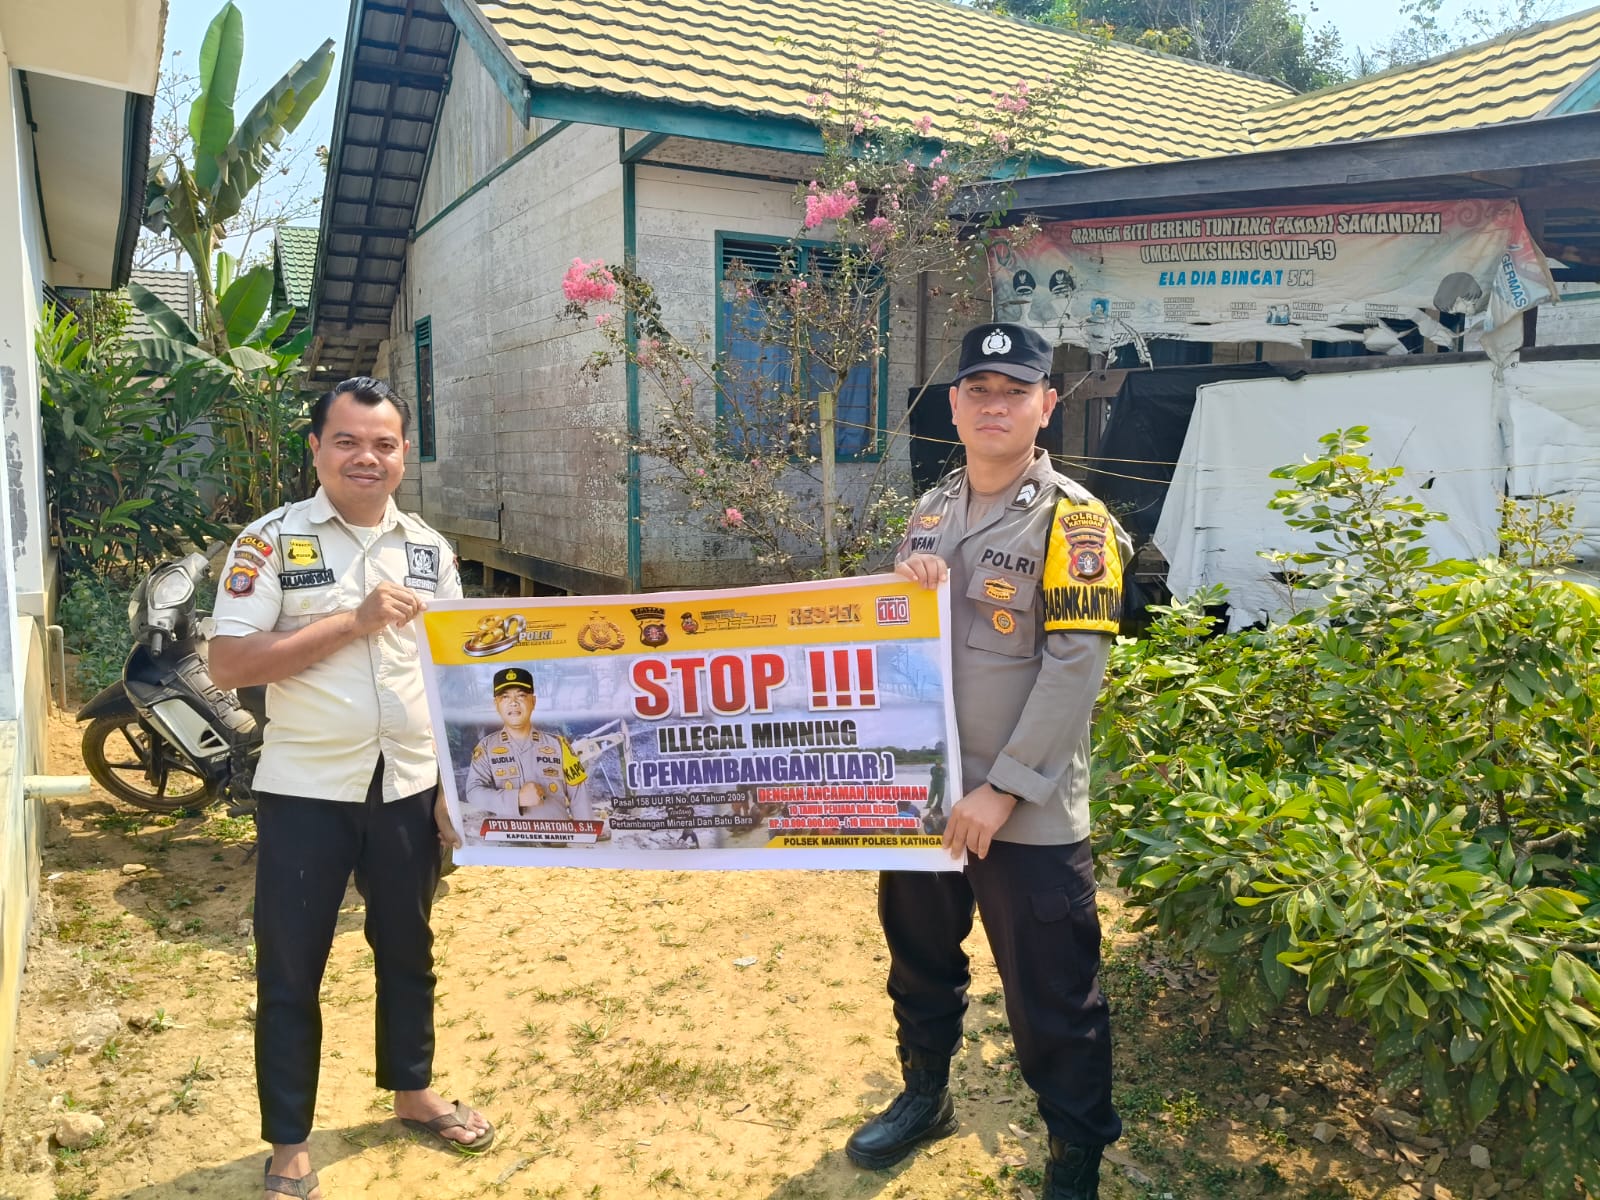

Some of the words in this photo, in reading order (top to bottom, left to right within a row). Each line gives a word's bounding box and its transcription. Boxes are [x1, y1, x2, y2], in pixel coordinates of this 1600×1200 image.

[1071, 225, 1121, 245] MAHAGA
[1123, 223, 1149, 241] BITI
[1150, 218, 1201, 239] BERENG
[1203, 215, 1272, 236] TUNTANG
[1273, 214, 1335, 234] PAHARI
[1140, 244, 1181, 263] UMBA
[1180, 241, 1259, 262] VAKSINASI
[1259, 239, 1337, 260] COVID-19
[1159, 272, 1186, 286] ELA
[1190, 271, 1216, 286] DIA
[1221, 269, 1284, 285] BINGAT
[1287, 269, 1314, 286] 5M
[1502, 253, 1527, 308] GERMAS
[1063, 512, 1105, 524] POLRES
[1068, 519, 1103, 528] KATINGAN
[981, 549, 1035, 575] POLRI
[788, 604, 861, 625] RESPEK
[879, 603, 906, 620] 110
[631, 652, 787, 718] STOP
[807, 647, 877, 709] !!!
[658, 725, 746, 753] ILLEGAL
[752, 720, 858, 749] MINNING
[613, 798, 634, 807] Pasal
[652, 796, 663, 805] UU
[665, 796, 674, 805] RI
[690, 795, 700, 804] 04
[702, 793, 725, 803] Tahun
[727, 792, 745, 802] 2009
[758, 787, 804, 802] DENGAN
[806, 786, 865, 801] ANCAMAN
[867, 786, 928, 801] HUKUMAN
[488, 821, 508, 830] IPTU
[511, 821, 531, 830] BUDI
[534, 822, 577, 832] HARTONO,
[580, 823, 596, 832] S.H.
[611, 820, 665, 831] Pertambangan
[667, 818, 695, 828] Mineral
[698, 817, 713, 826] Dan
[715, 816, 732, 825] Batu
[734, 815, 752, 824] Bara
[784, 837, 819, 846] POLSEK
[821, 837, 860, 846] MARIKIT
[862, 837, 898, 846] POLRES
[900, 837, 941, 846] KATINGA
